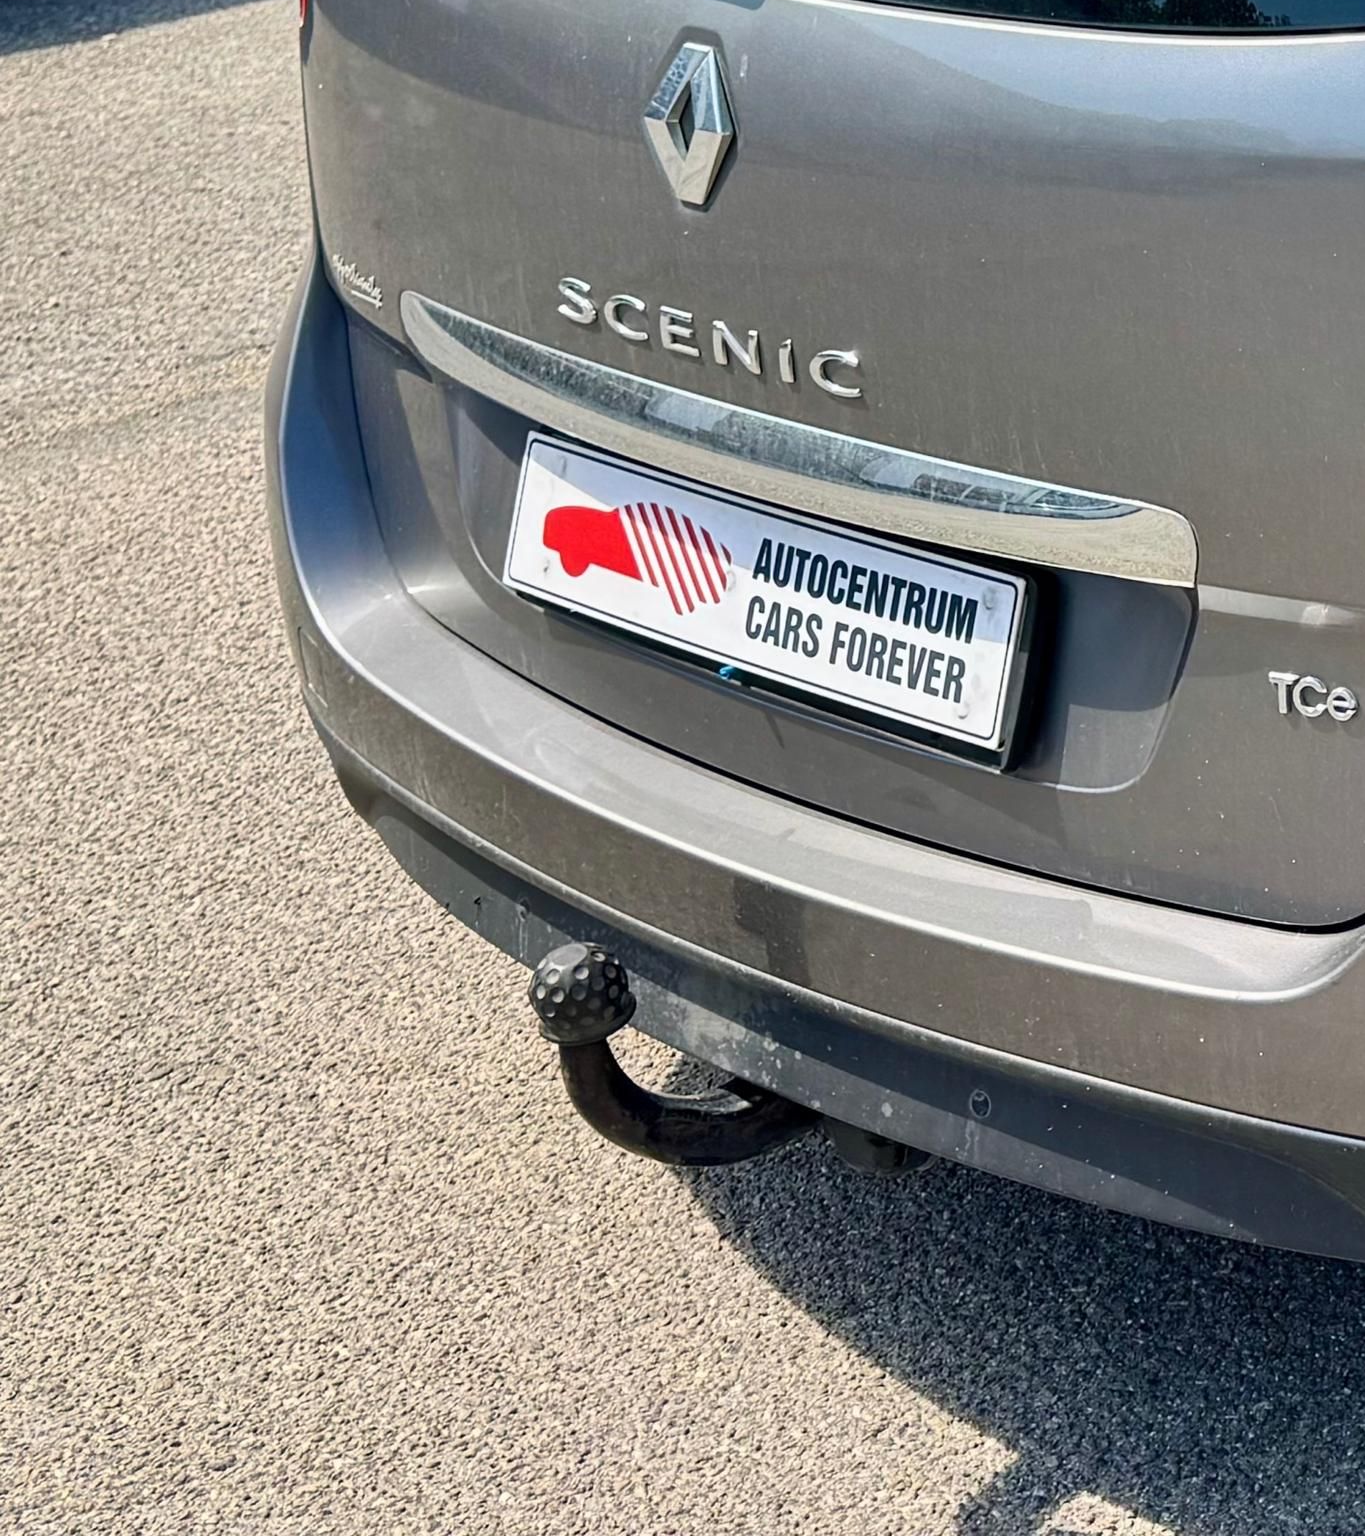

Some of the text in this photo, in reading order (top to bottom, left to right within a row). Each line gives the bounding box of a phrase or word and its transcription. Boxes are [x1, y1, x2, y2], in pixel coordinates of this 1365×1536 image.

[557, 276, 864, 398] SCENIC
[751, 537, 979, 645] AUTOCENTRUM
[745, 595, 967, 704] CARS FOREVER
[1267, 670, 1359, 722] TCe
